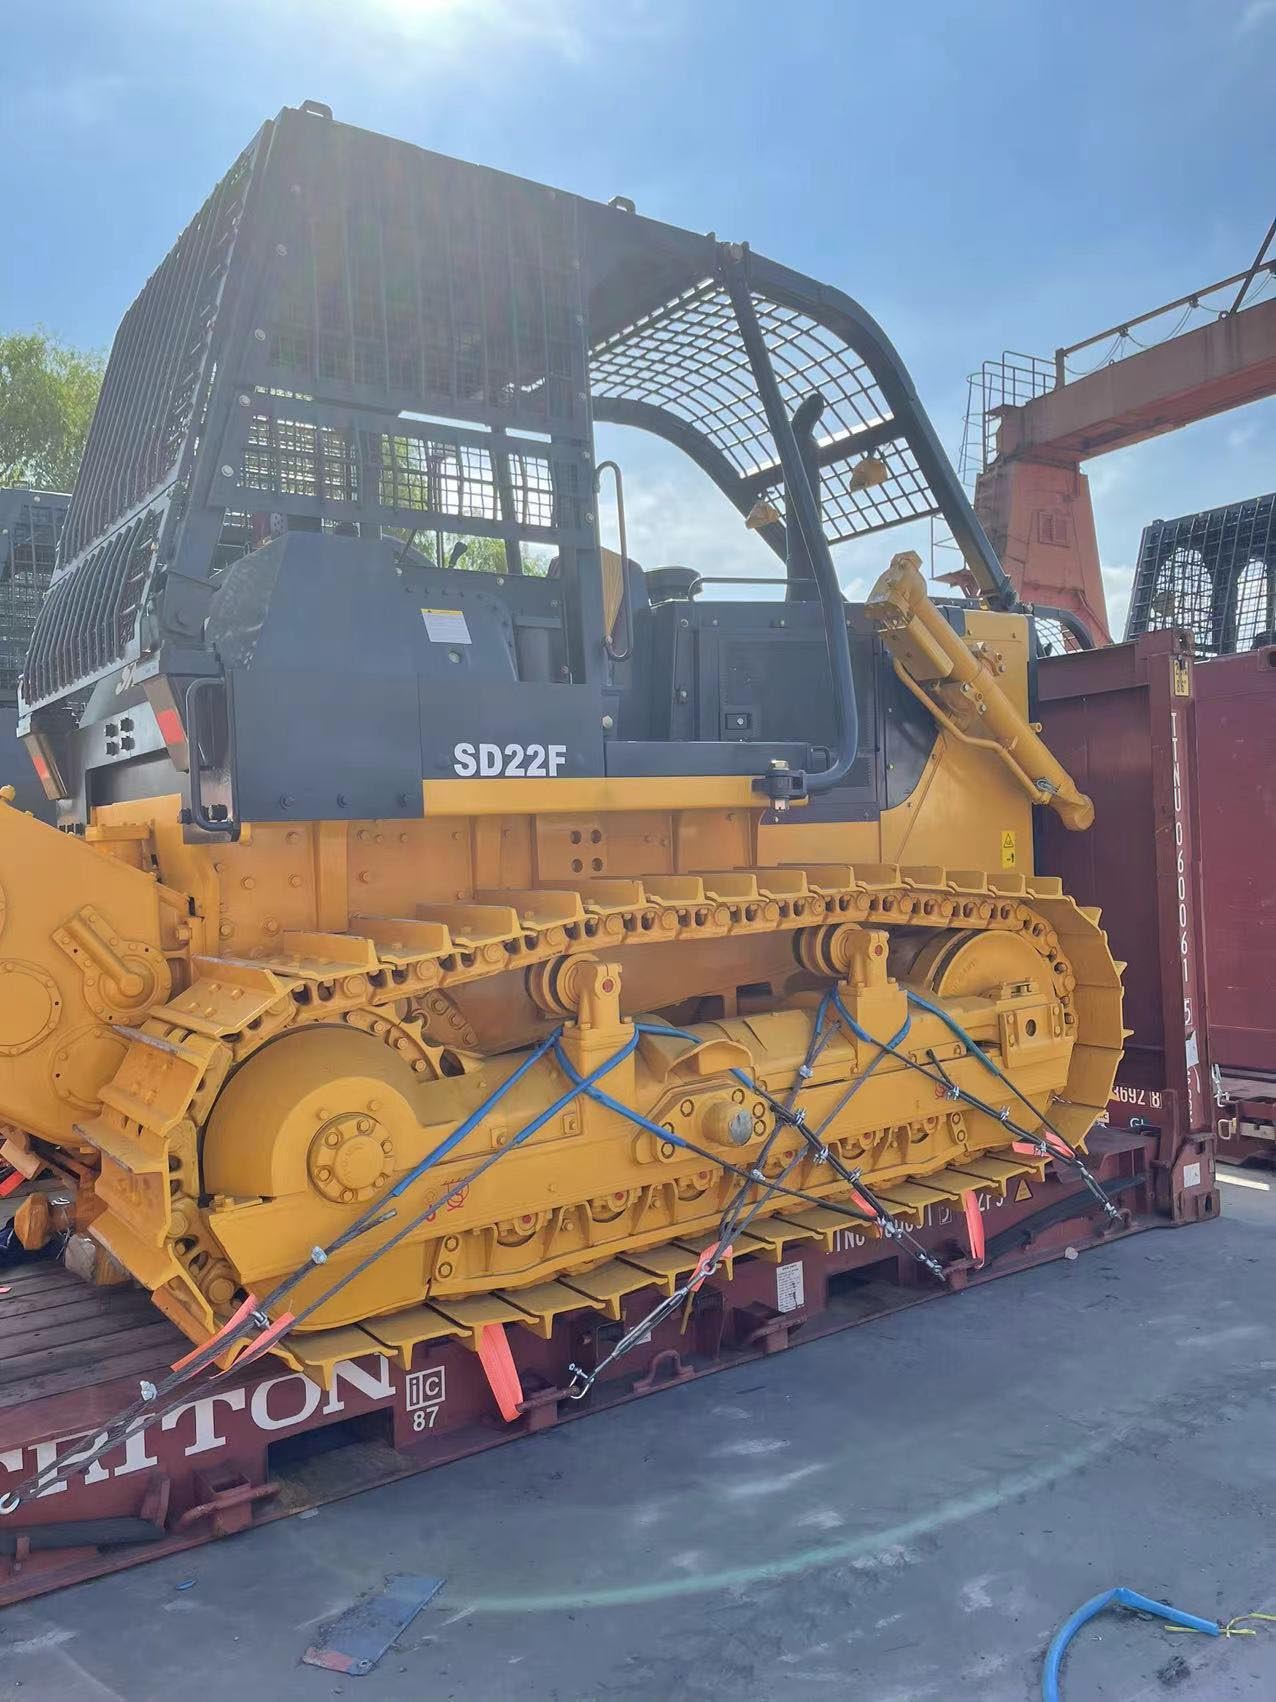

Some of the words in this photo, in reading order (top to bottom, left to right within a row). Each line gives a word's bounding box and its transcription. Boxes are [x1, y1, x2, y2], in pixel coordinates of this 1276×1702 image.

[453, 743, 567, 777] SD22F
[1171, 712, 1181, 812] TTNU
[1176, 822, 1188, 982] 060061
[0, 1352, 396, 1498] RITON
[413, 1406, 439, 1432] 87
